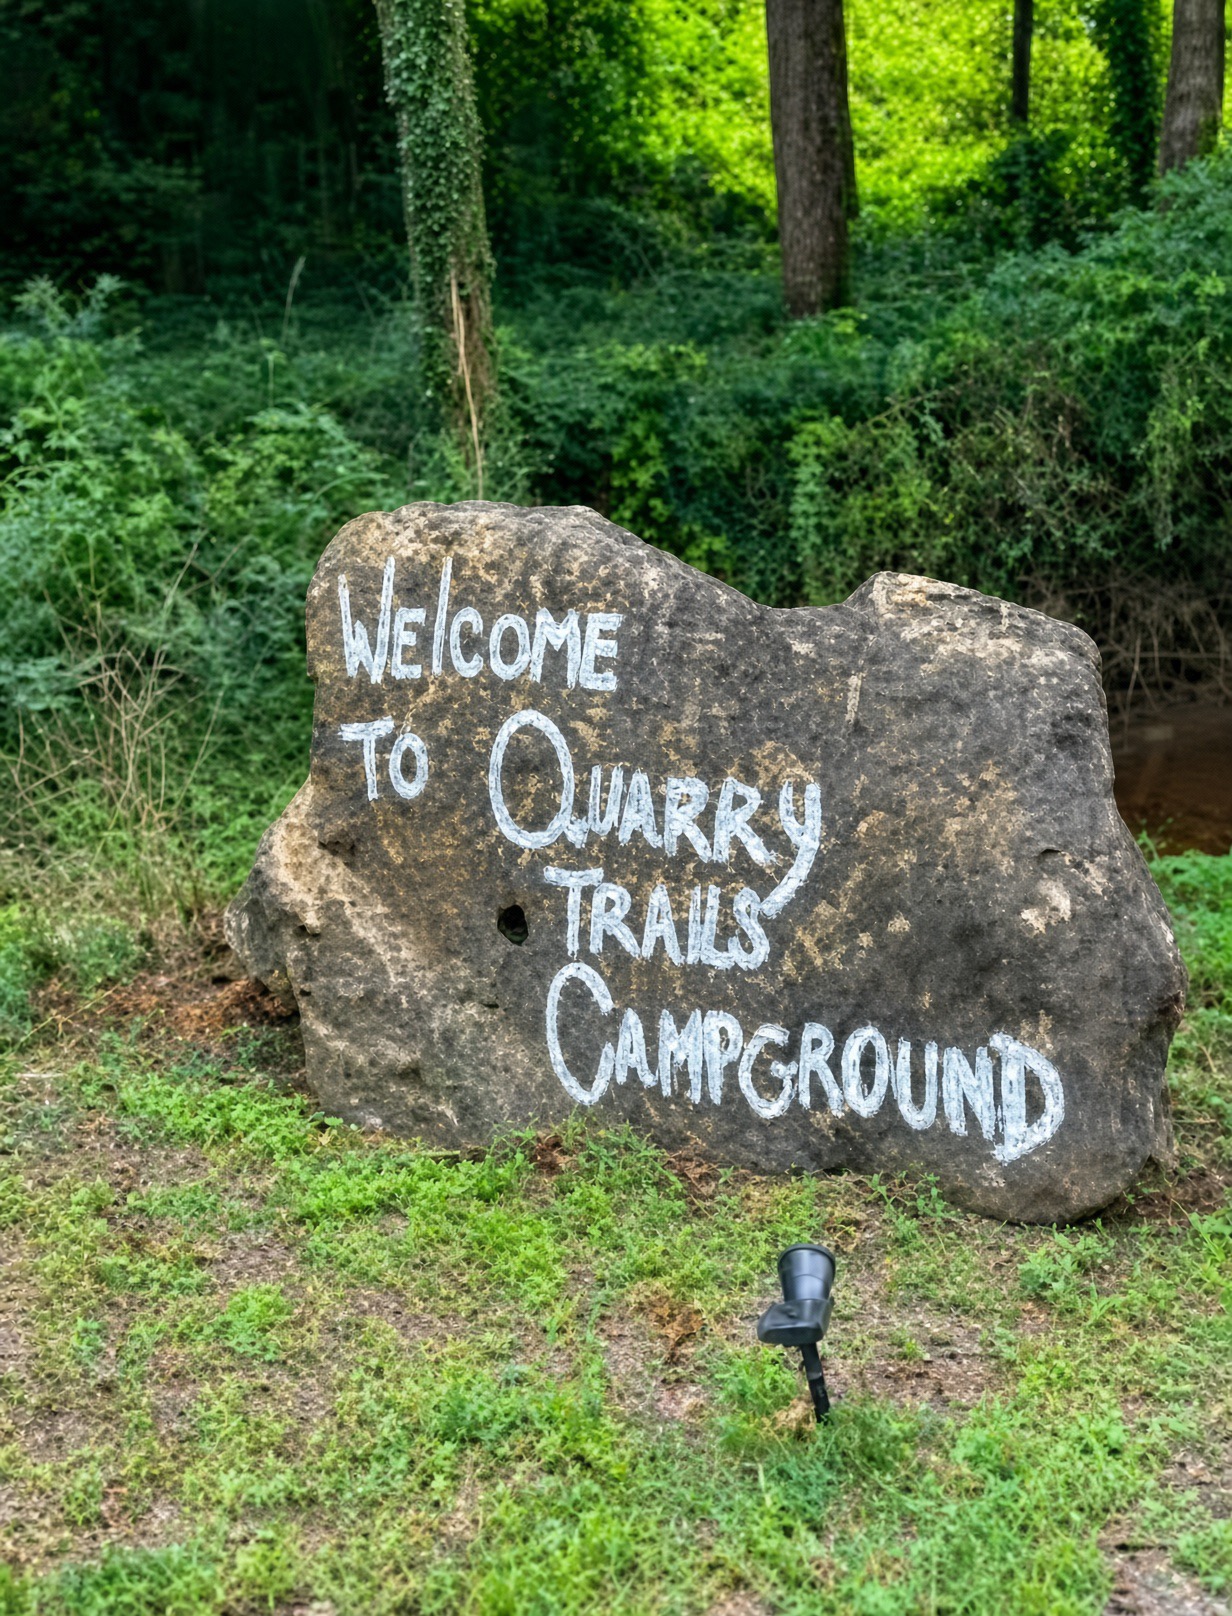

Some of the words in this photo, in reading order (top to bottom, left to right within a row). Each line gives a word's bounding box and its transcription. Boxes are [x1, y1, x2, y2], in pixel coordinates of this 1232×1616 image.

[338, 716, 429, 801] TO
[543, 865, 770, 971] TRAILS
[546, 961, 1065, 1165] CAMPGROUND
